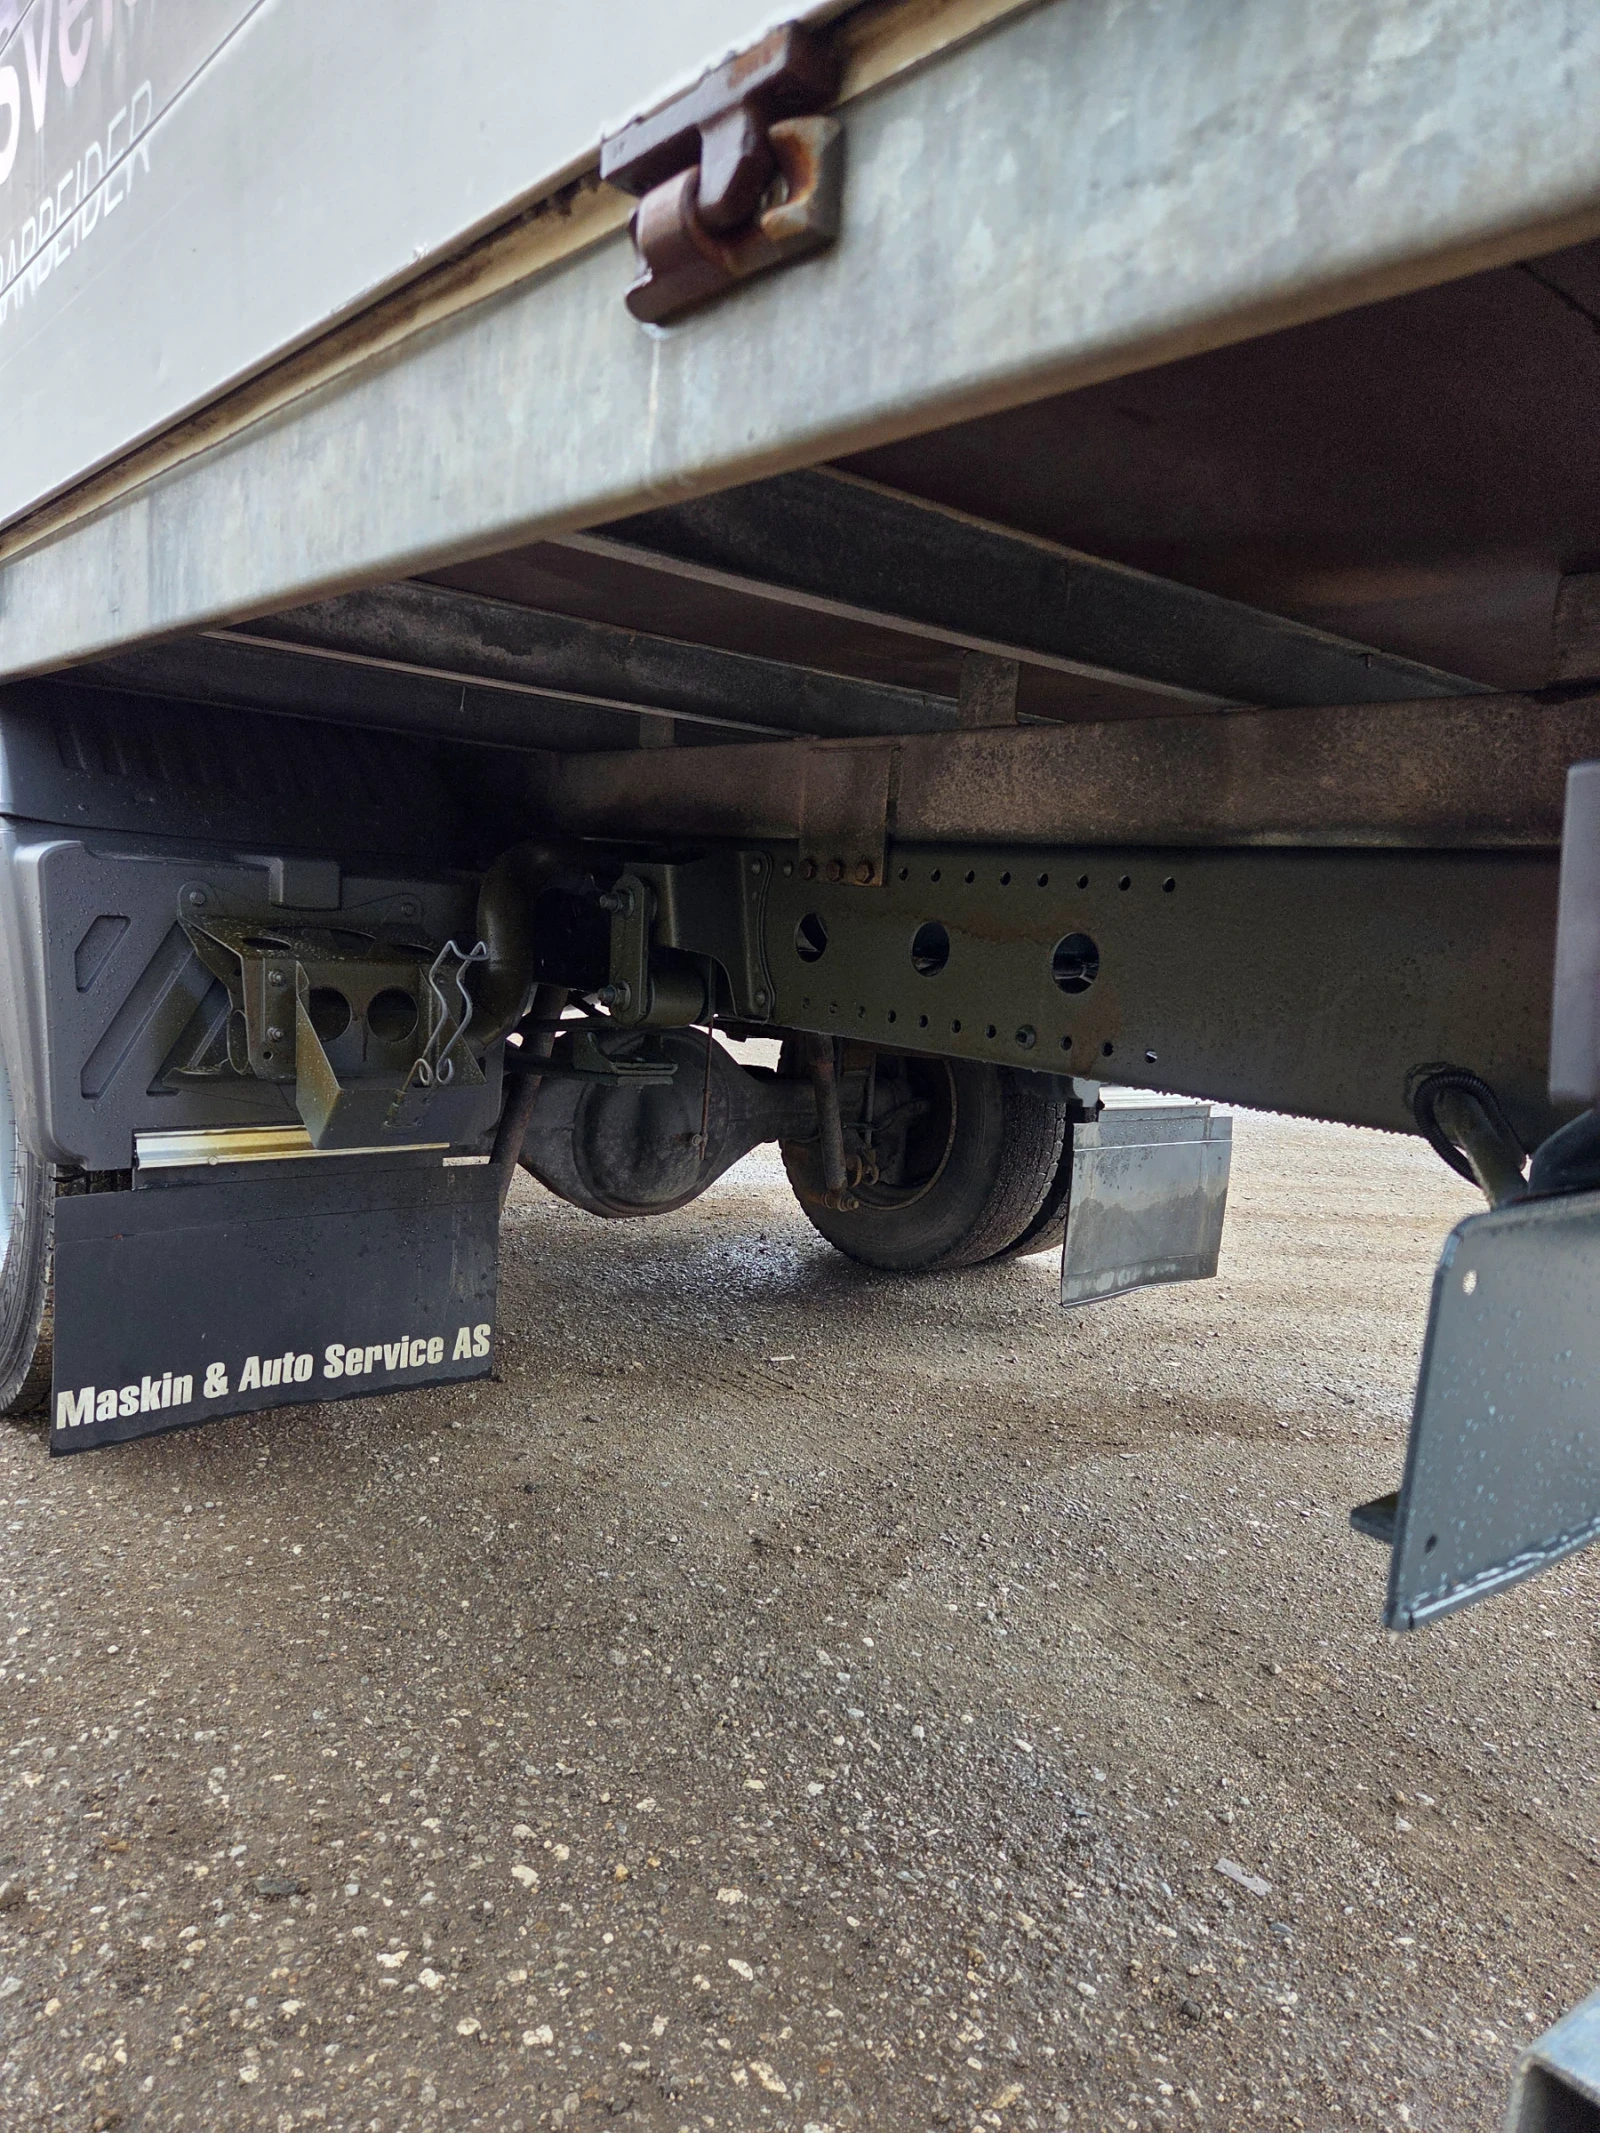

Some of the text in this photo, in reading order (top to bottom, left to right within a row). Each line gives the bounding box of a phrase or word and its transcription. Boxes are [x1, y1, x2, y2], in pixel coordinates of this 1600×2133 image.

[0, 79, 153, 326] ARBEIDER
[57, 1324, 491, 1429] Maskin & Auto Service AS
